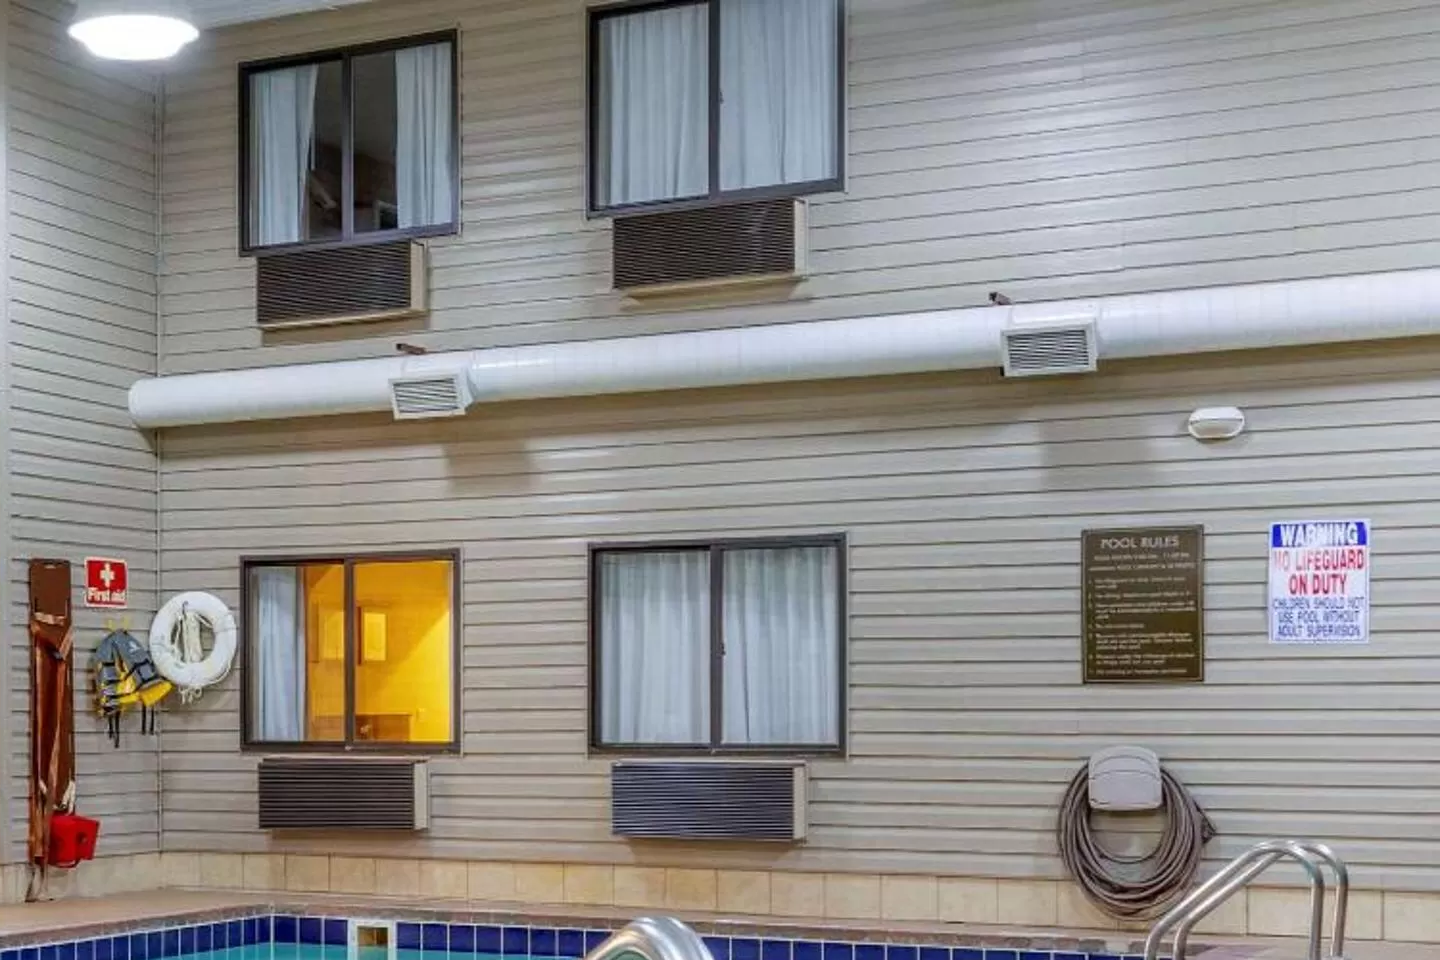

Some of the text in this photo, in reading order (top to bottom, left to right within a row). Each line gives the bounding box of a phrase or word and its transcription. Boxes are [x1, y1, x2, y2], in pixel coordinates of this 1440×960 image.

[1101, 535, 1179, 549] POOL RULES
[1281, 523, 1359, 547] WARNING
[1274, 549, 1364, 570] NO LIFEGUARD
[1289, 573, 1347, 594] ON DUTY
[1273, 597, 1311, 609] CHILDREN
[1278, 611, 1294, 623] USE
[1297, 610, 1320, 623] POOL
[1277, 625, 1304, 637] ADULT
